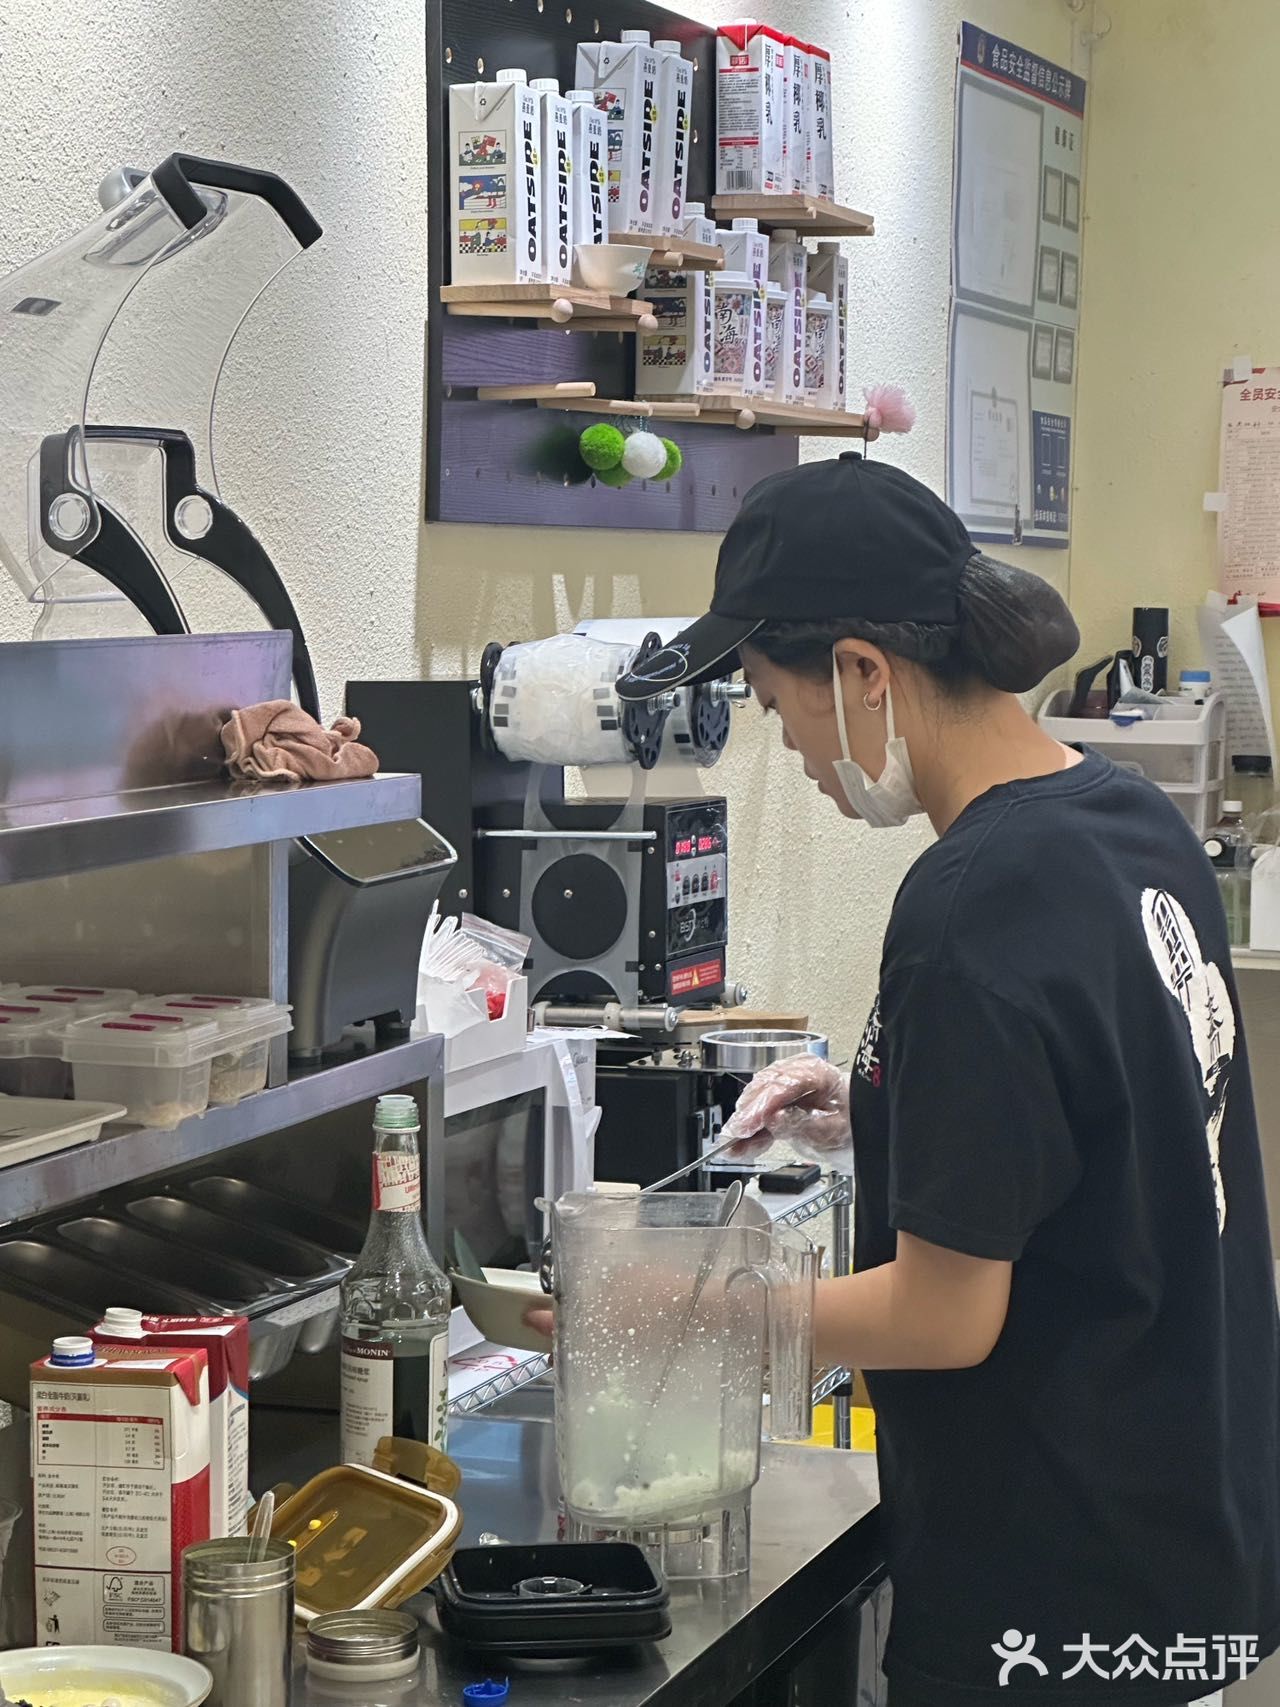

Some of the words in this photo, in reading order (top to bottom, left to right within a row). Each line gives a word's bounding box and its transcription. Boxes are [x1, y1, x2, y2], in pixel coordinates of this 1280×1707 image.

[523, 120, 537, 262] OATSIDE
[556, 130, 568, 269] OATSIDE
[589, 141, 603, 244] ATSIDE
[639, 80, 654, 213] OATSIDE
[671, 90, 686, 220] OATSIDE
[793, 271, 802, 388] OATSIDE
[1240, 388, 1280, 401] 全员安
[356, 1347, 389, 1357] MONIN
